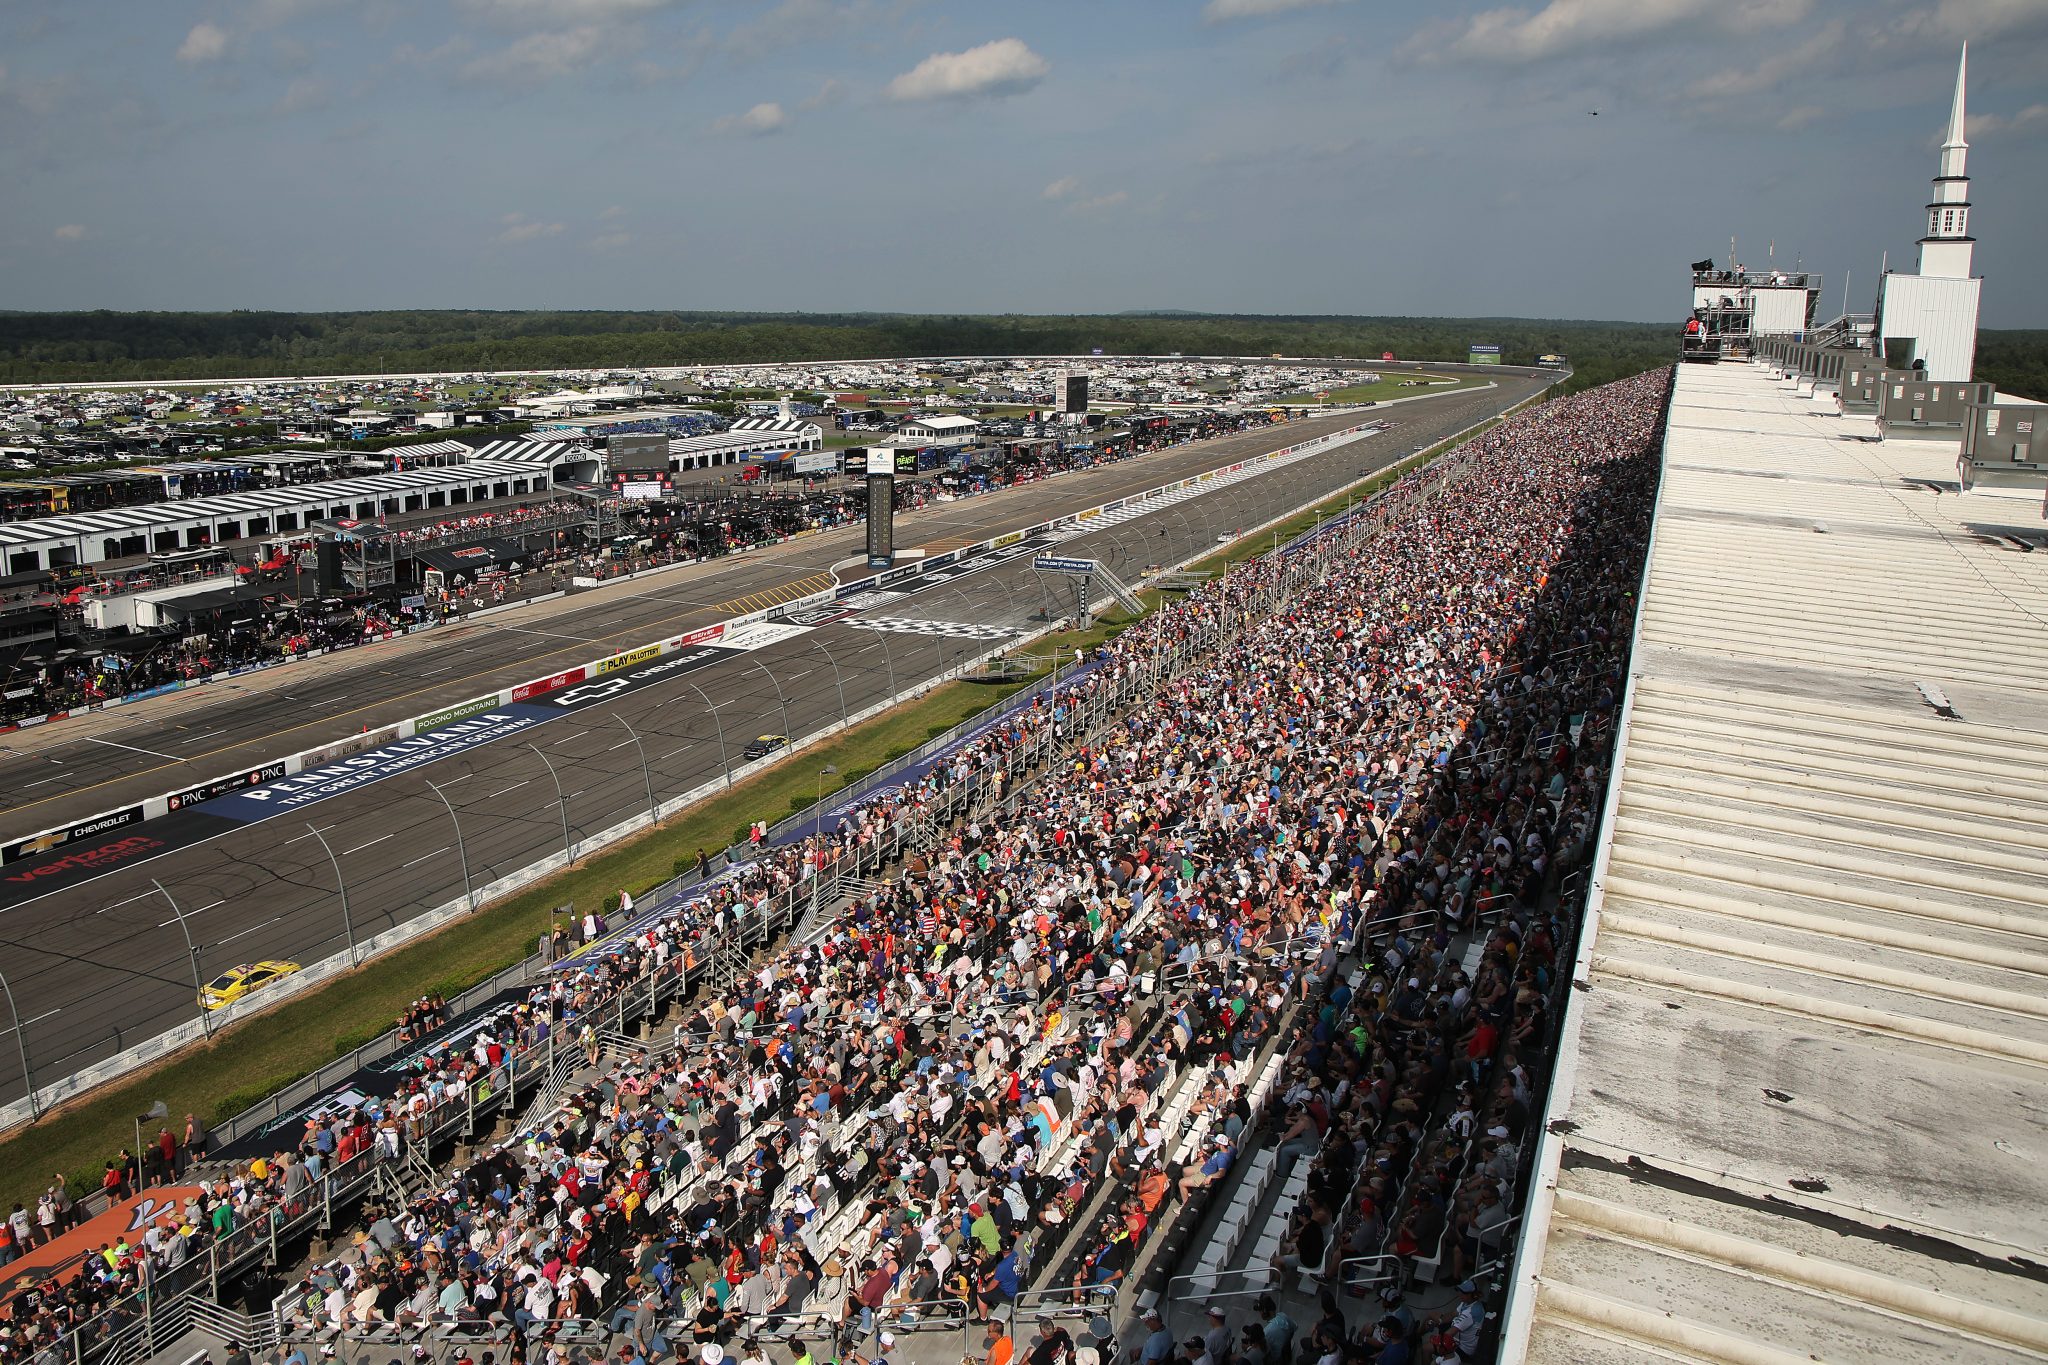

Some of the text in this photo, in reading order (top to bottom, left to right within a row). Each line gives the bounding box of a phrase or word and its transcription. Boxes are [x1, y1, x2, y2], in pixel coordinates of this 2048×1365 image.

[566, 453, 585, 462] POCONO
[400, 606, 413, 614] 48
[472, 598, 484, 608] 42
[607, 647, 660, 670] PLAY PA LOTTERY
[628, 648, 720, 679] CHEVROLET
[96, 675, 103, 687] 7
[418, 699, 496, 729] POCONO MOUNTAINS
[241, 713, 514, 800] PENNSYLVANIA
[277, 717, 536, 805] THE GREAT AMERICAN GETAWAY
[182, 789, 206, 806] PNC
[261, 765, 284, 781] PNC
[74, 813, 131, 837] CHEVROLET
[4, 835, 153, 882] verizon
